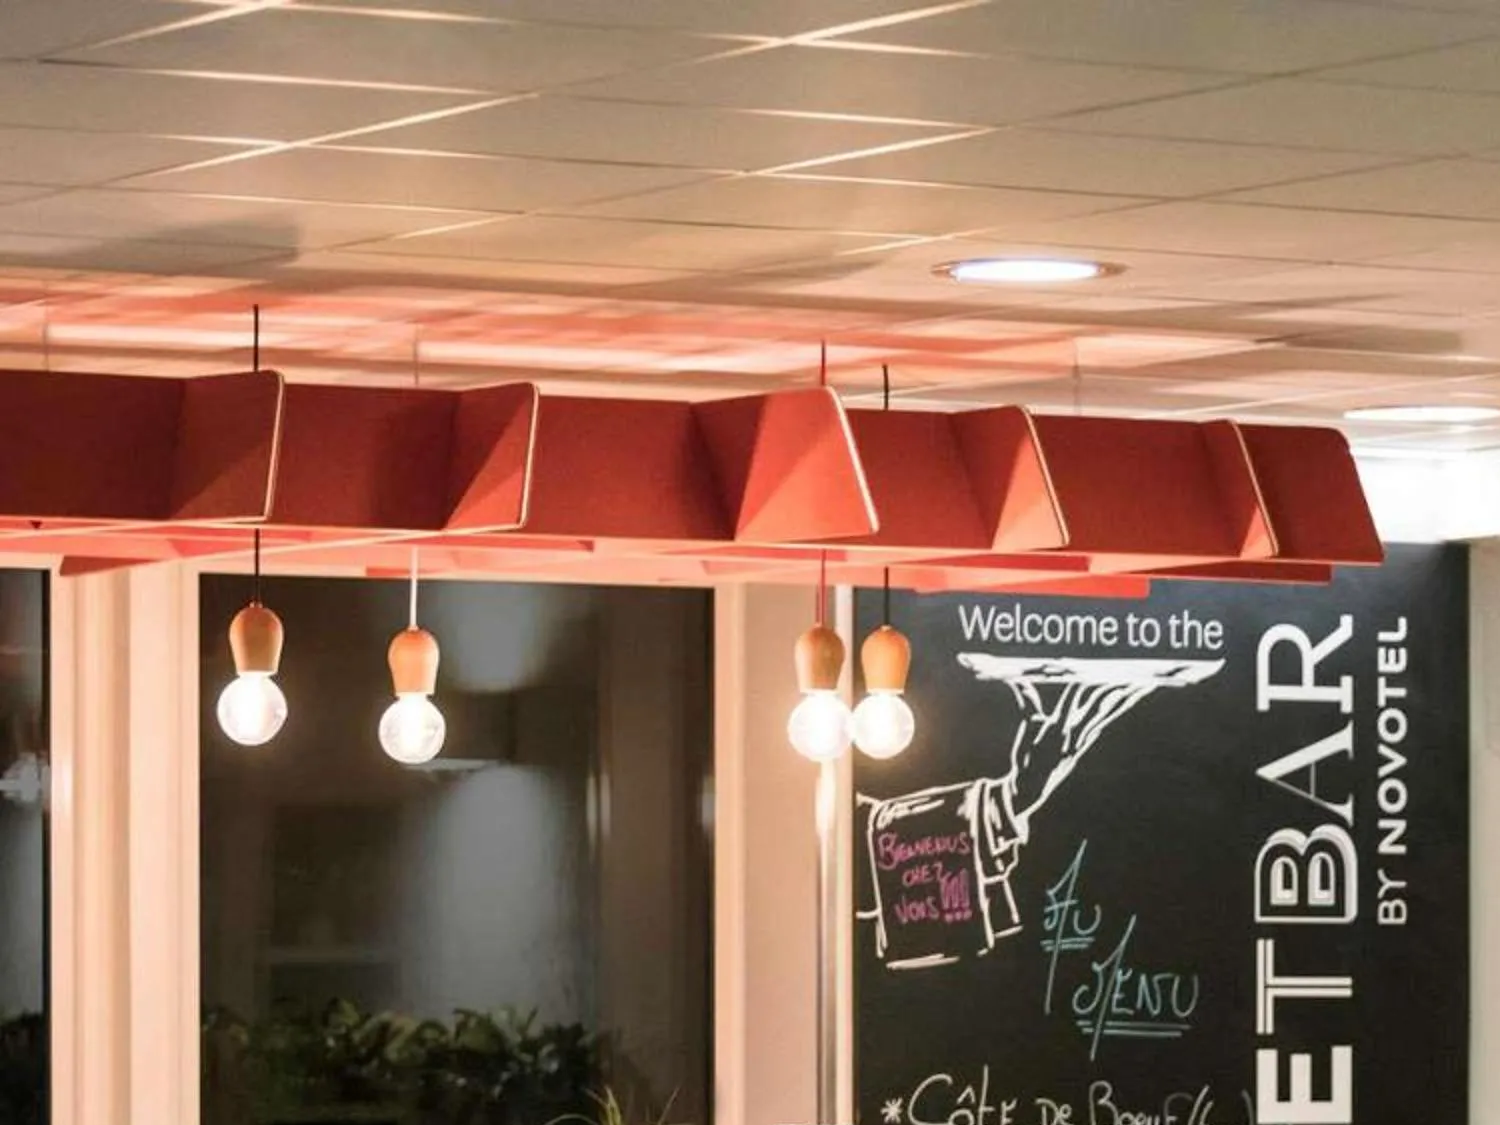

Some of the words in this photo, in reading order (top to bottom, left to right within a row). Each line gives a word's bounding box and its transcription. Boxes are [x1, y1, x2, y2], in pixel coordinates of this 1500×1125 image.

[958, 603, 1119, 646] Welcome
[1126, 612, 1161, 647] to
[1168, 609, 1224, 649] the
[1377, 616, 1408, 855] NOVOTEL
[1377, 868, 1408, 925] BY
